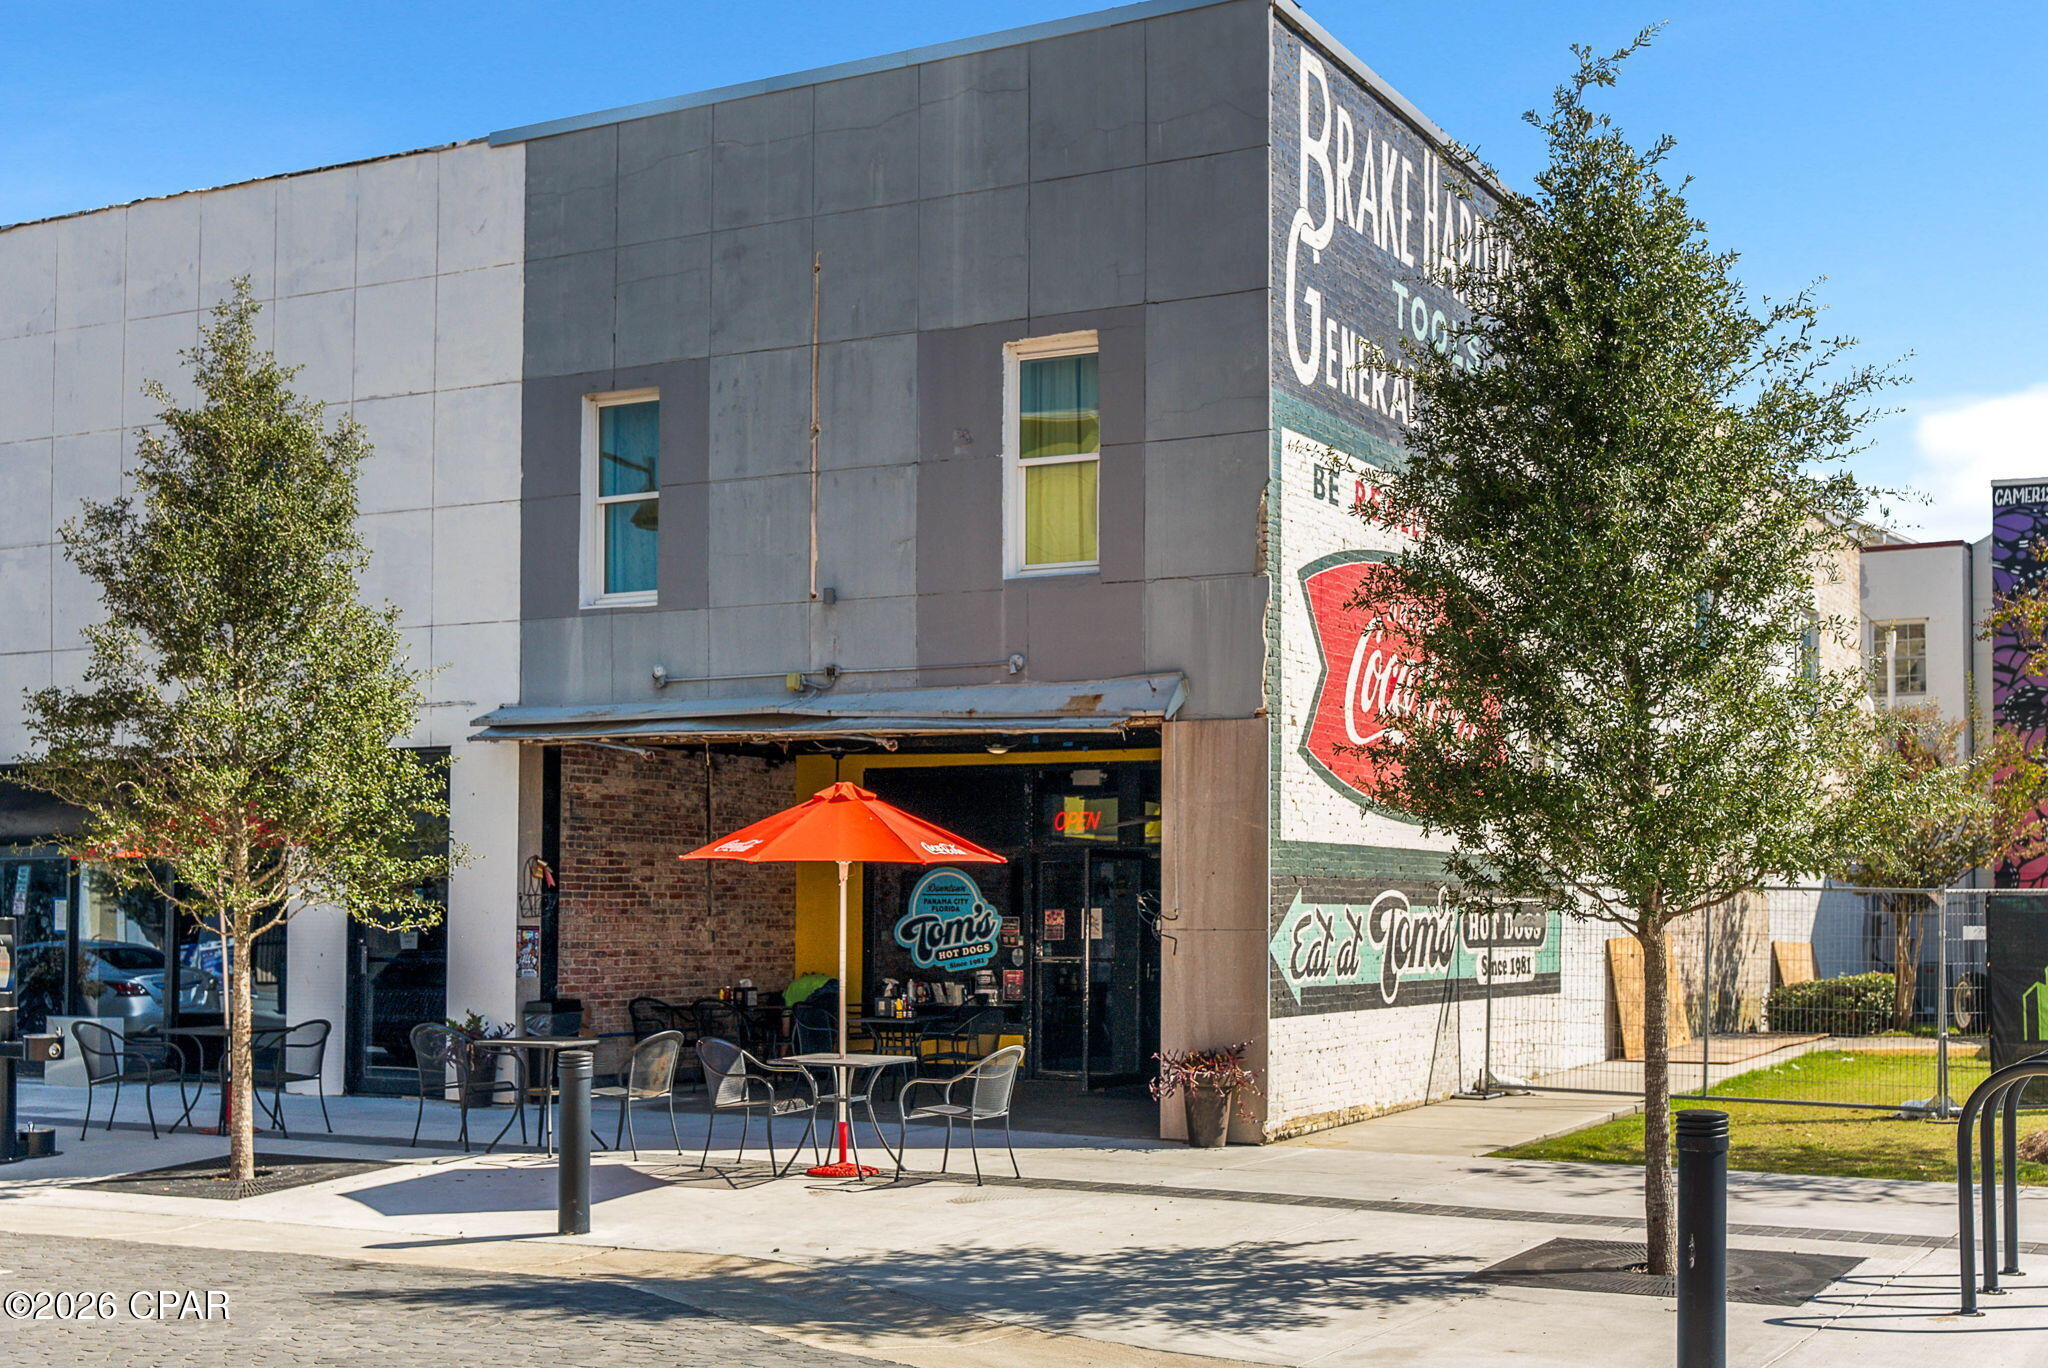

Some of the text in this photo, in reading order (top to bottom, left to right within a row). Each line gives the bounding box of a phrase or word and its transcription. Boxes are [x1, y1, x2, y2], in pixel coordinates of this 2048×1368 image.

[1299, 46, 1415, 268] BRAKE
[1392, 279, 1481, 375] TOOLS
[1313, 463, 1339, 507] BE
[1053, 811, 1102, 831] OPEN
[900, 903, 997, 962] Tom's
[938, 943, 991, 960] HOT DOGS
[1290, 906, 1364, 978] Eat at
[1369, 888, 1455, 1000] Tom's
[1468, 911, 1500, 941] HOT
[1481, 954, 1532, 978] Snce 1981
